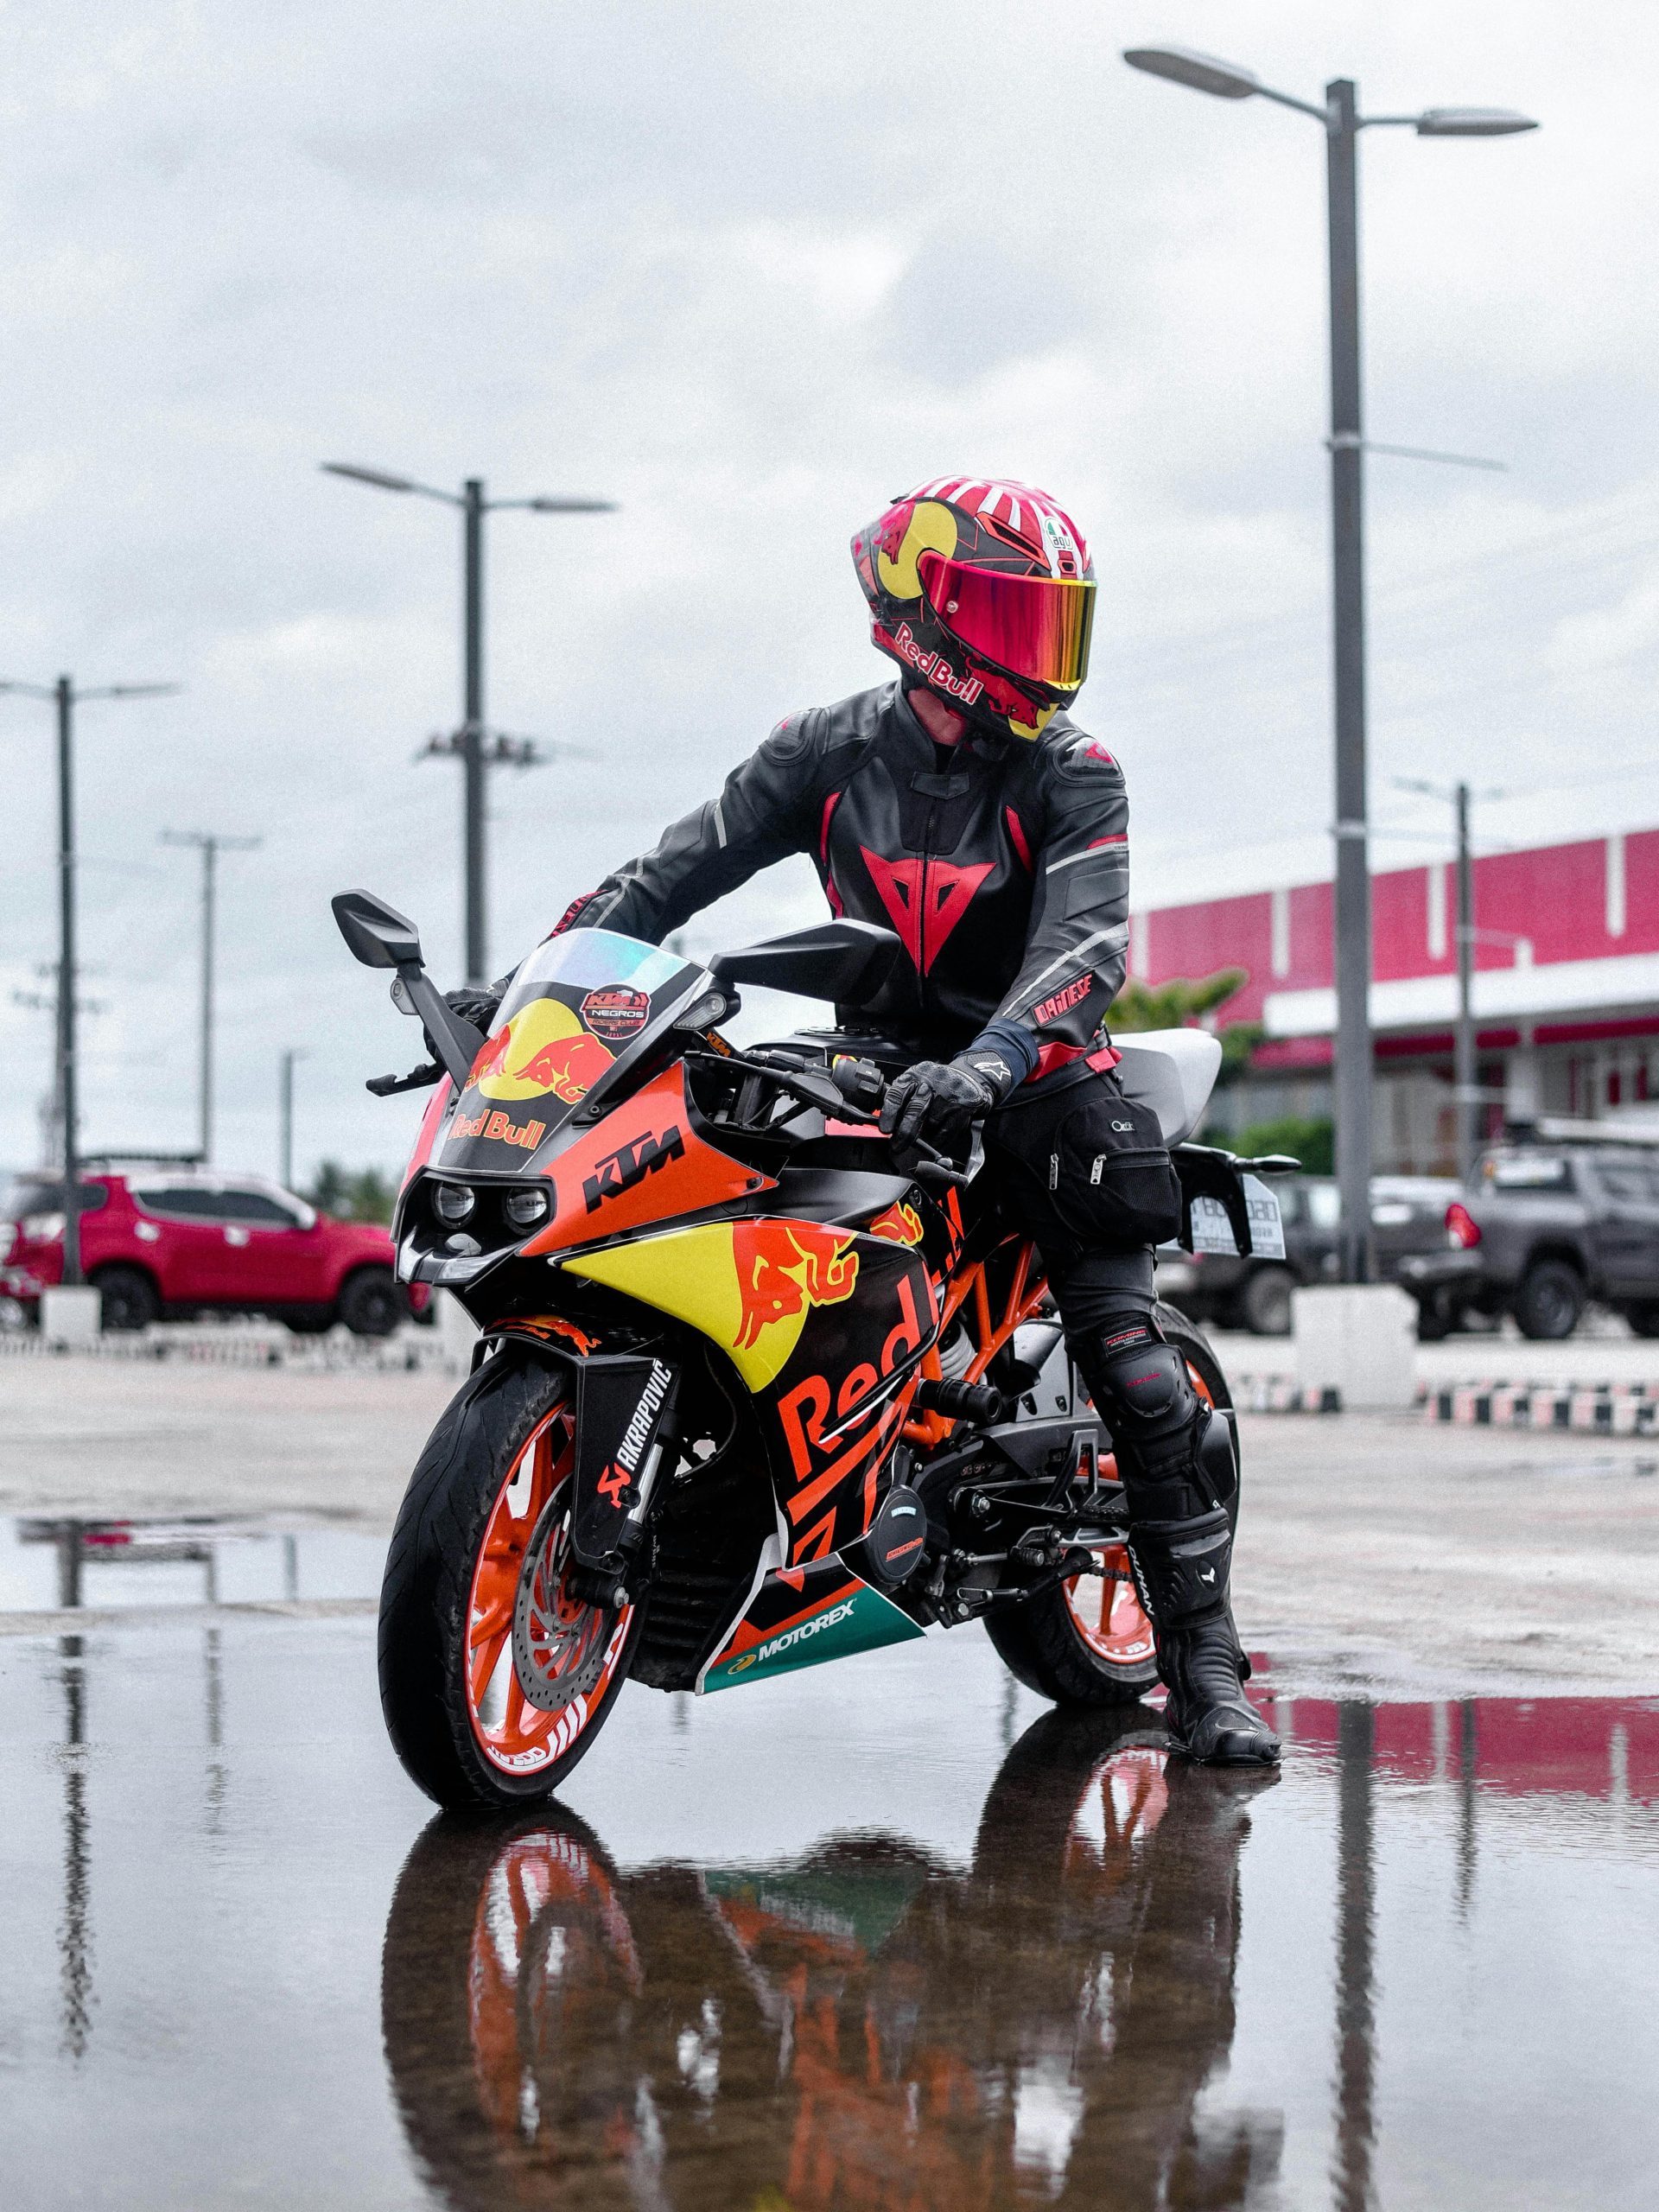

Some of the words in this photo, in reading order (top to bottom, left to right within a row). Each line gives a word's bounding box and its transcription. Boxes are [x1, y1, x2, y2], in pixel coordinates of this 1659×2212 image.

[895, 622, 938, 675] Red
[930, 658, 984, 706] Bull
[591, 1009, 645, 1019] NEGROS
[706, 1032, 732, 1058] KTM
[448, 1109, 491, 1141] Red
[484, 1110, 546, 1150] Bull
[582, 1124, 686, 1215] KTM
[778, 1274, 922, 1483] Red
[1128, 1544, 1155, 1616] DUHAN
[759, 1599, 855, 1662] MOTOREX
